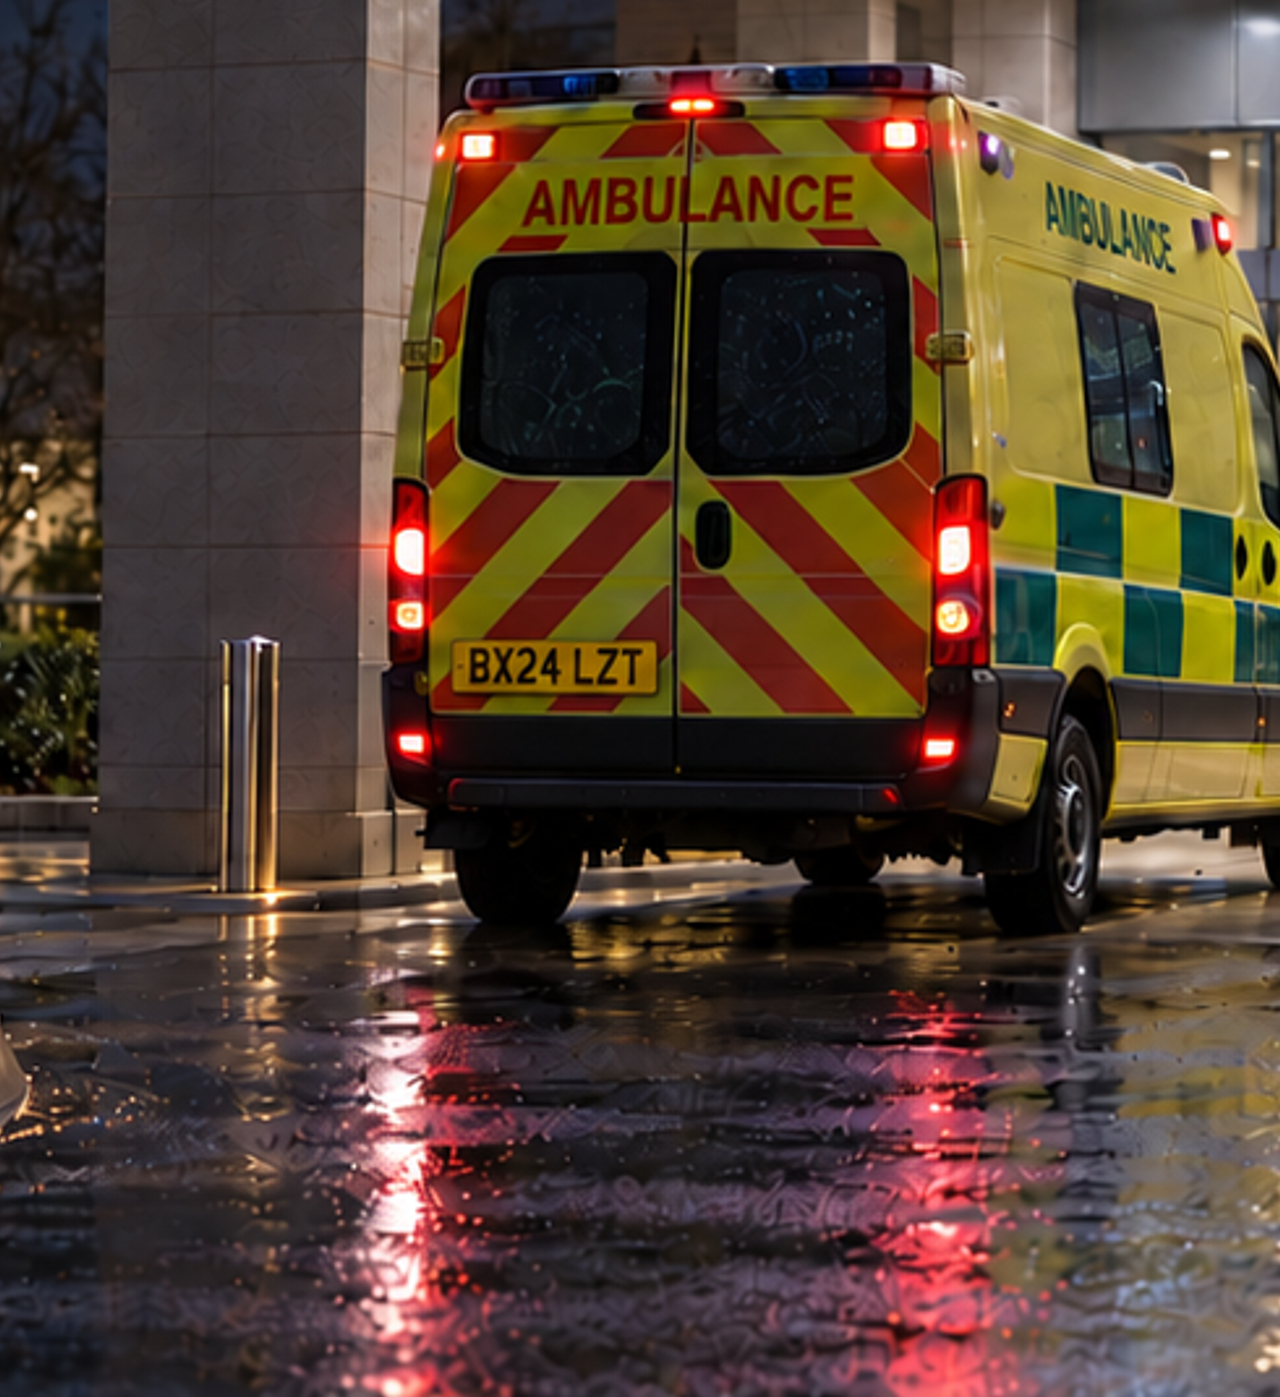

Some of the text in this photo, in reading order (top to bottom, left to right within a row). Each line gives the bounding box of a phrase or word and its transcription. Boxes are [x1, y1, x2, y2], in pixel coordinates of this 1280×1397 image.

[523, 174, 854, 227] AMBULANCE
[1045, 182, 1176, 273] AMBULANCE
[468, 646, 643, 685] BX24 LZT
